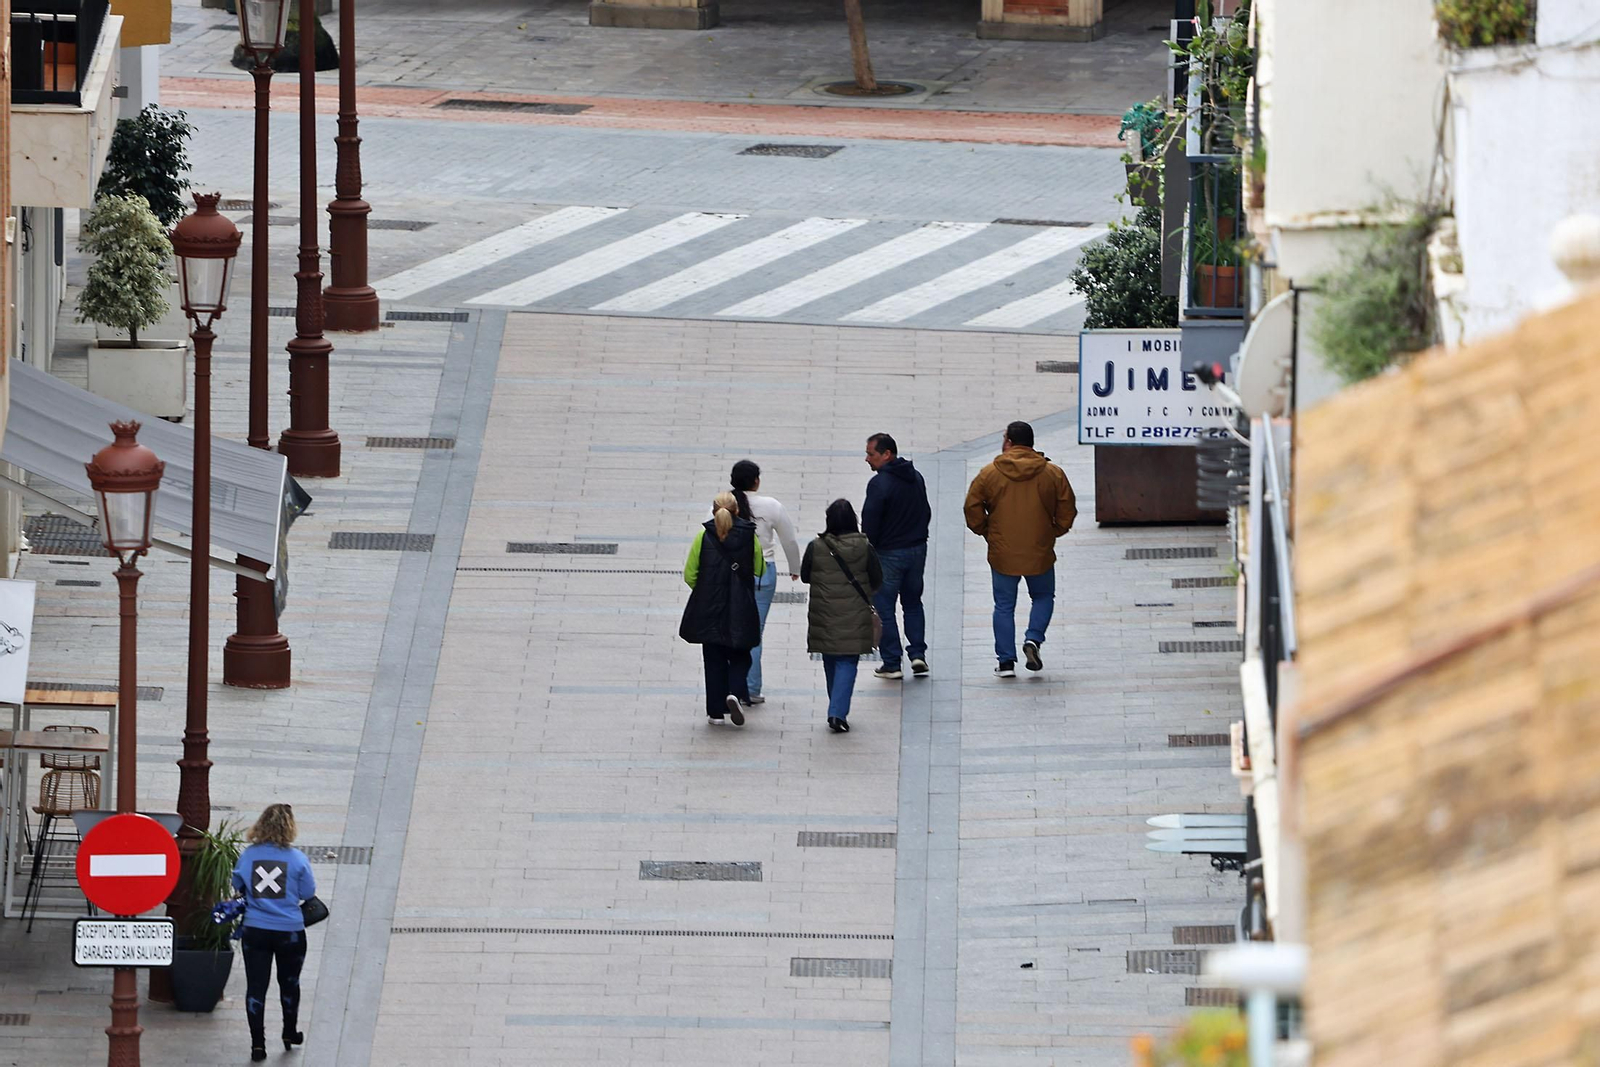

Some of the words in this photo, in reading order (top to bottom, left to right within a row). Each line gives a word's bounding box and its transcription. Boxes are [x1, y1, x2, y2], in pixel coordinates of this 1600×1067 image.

[1142, 340, 1181, 352] MOBI
[1087, 407, 1119, 417] ADMON
[1085, 427, 1115, 438] TLF
[77, 924, 107, 939] EXCEPTO
[133, 924, 172, 939] RESIDENTES
[83, 945, 113, 959] GARAJES
[122, 945, 135, 959] SAN
[137, 945, 172, 959] SALVADOR
